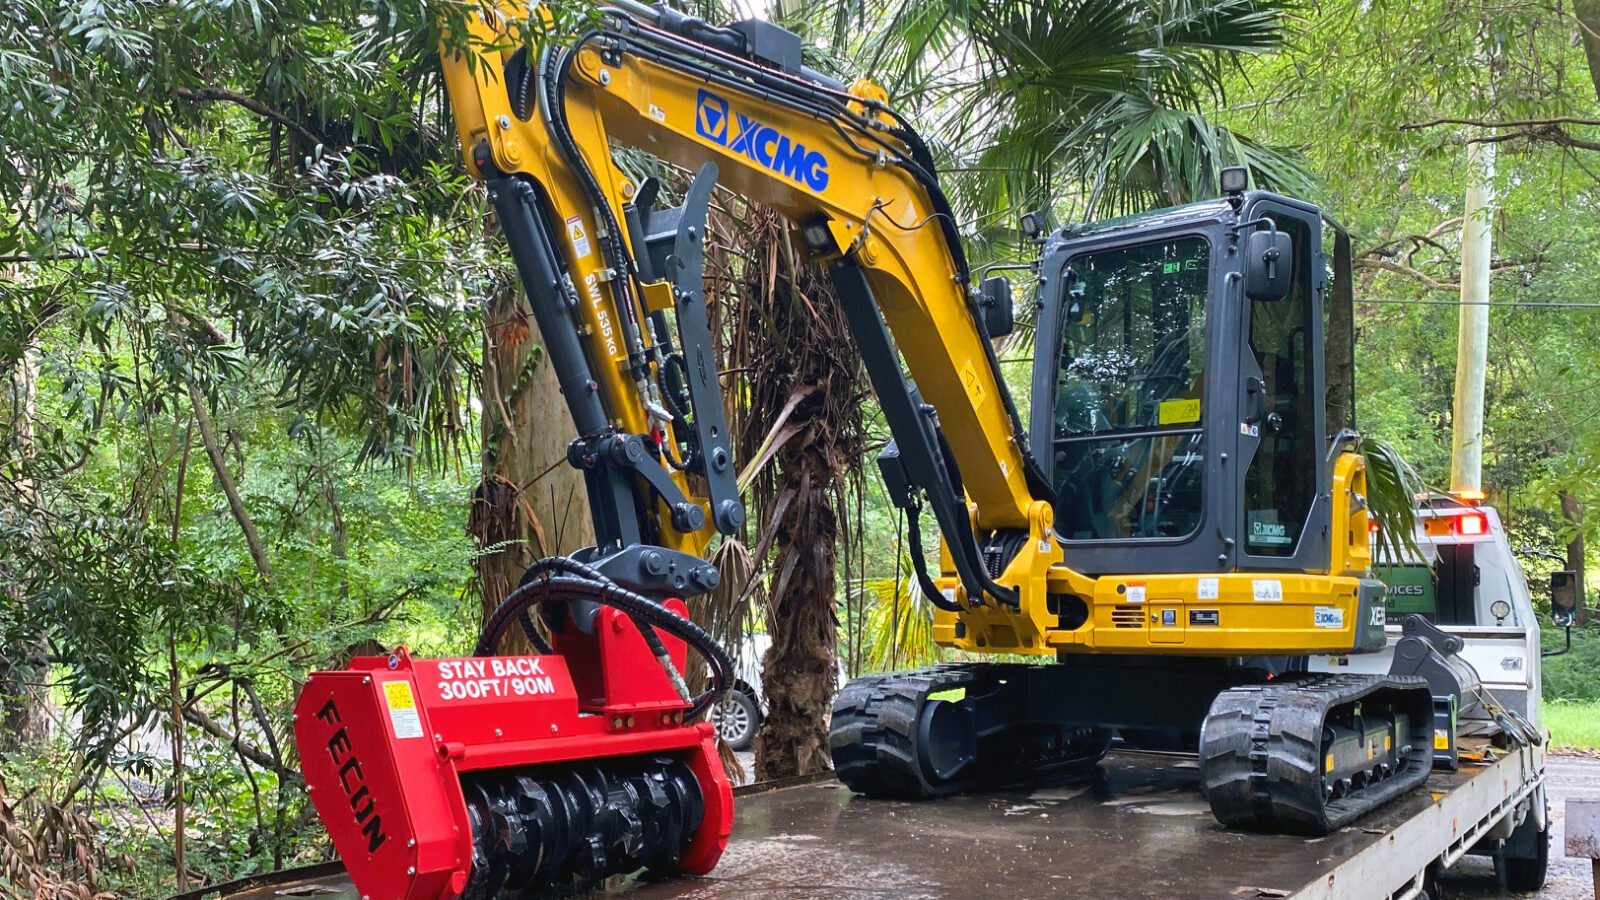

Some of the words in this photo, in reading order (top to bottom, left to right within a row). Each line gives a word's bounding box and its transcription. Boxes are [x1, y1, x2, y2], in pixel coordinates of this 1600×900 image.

[727, 111, 830, 192] XCMG
[585, 272, 603, 310] SWL
[596, 309, 613, 337] 535
[605, 336, 617, 356] KG
[1262, 523, 1286, 537] XCMG
[438, 660, 485, 679] STAY
[491, 657, 545, 678] BACK
[316, 699, 387, 854] FECON
